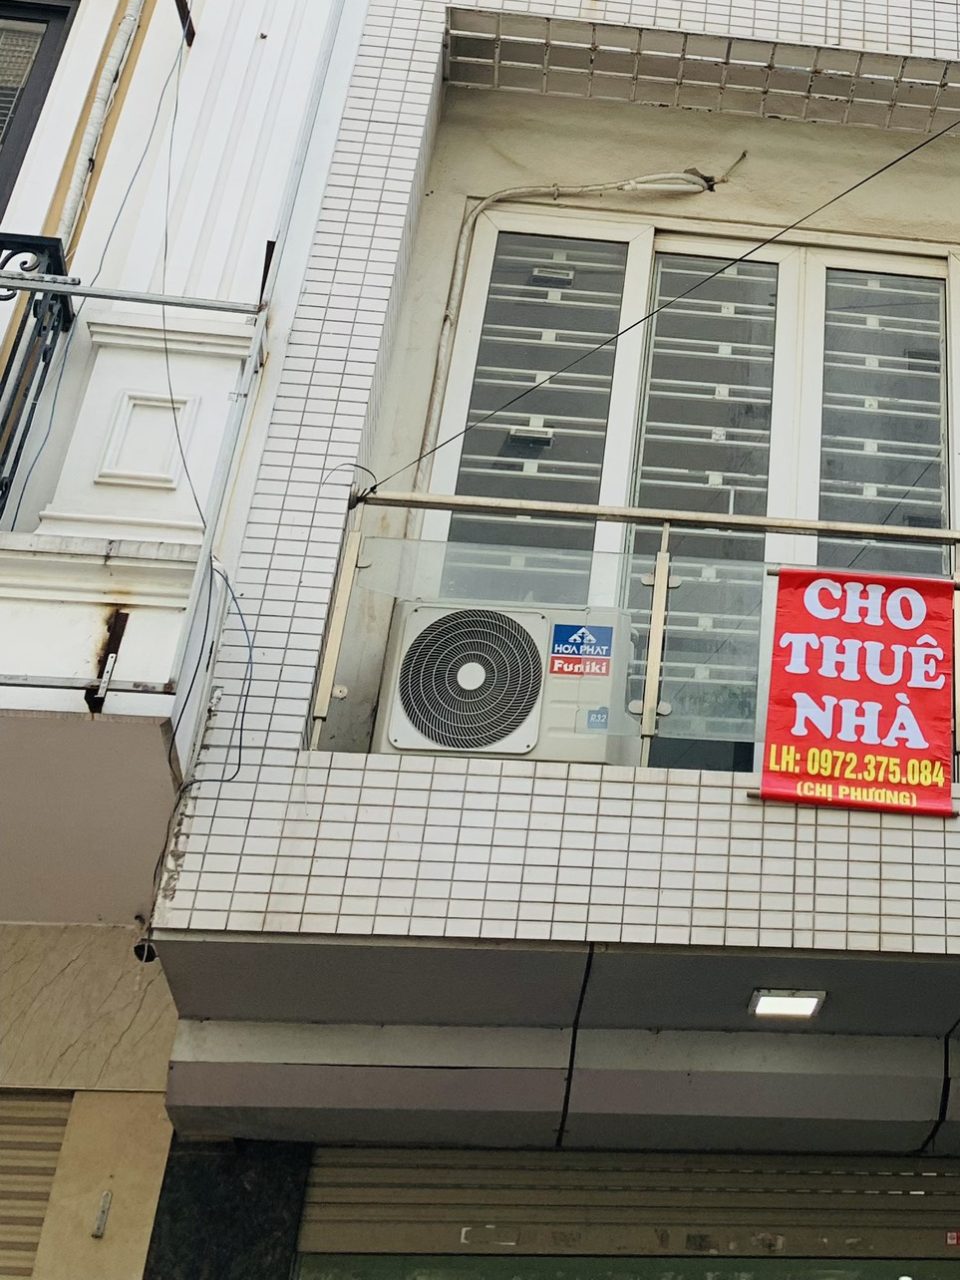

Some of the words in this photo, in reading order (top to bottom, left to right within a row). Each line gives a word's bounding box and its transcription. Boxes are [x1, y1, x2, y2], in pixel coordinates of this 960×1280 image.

[803, 578, 927, 630] CHO
[552, 660, 606, 673] Funiki
[779, 632, 946, 690] THUÊ
[590, 714, 606, 722] R32
[790, 692, 930, 749] NHÀ
[769, 743, 801, 774] LH:
[806, 747, 945, 788] 0972.375.084
[796, 781, 834, 801] (CHỊ
[838, 785, 918, 807] PHƯƠNG)
